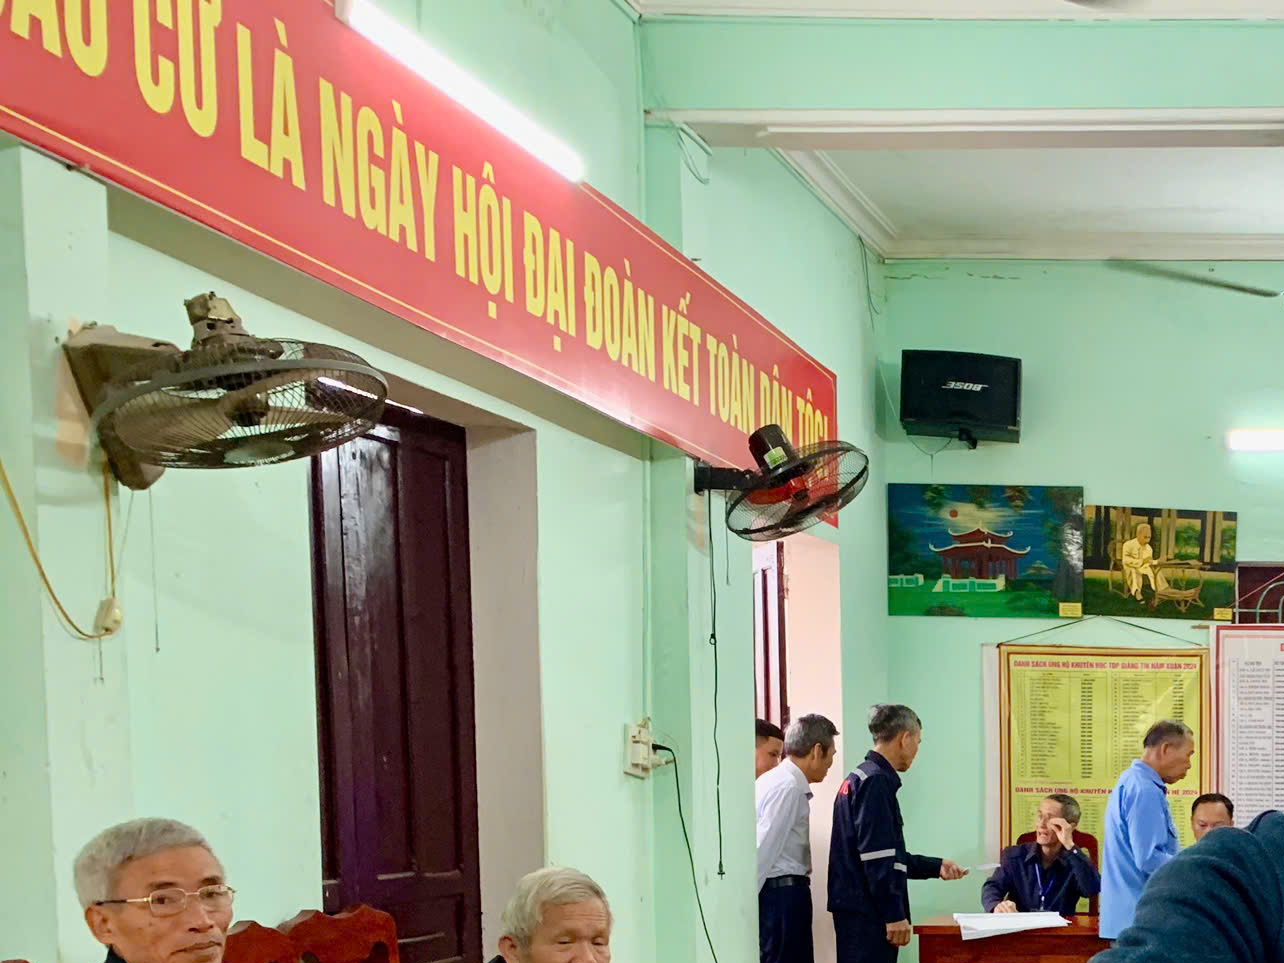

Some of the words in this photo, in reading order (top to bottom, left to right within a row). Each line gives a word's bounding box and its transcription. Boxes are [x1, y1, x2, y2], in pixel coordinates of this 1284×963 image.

[236, 17, 306, 192] LÀ
[319, 76, 440, 263] NGÀY
[452, 160, 515, 320] HỘI
[523, 209, 577, 353] ĐẠI
[584, 250, 656, 384] ĐOÀN
[661, 291, 702, 407] KẾT
[706, 333, 755, 436] TOÀN
